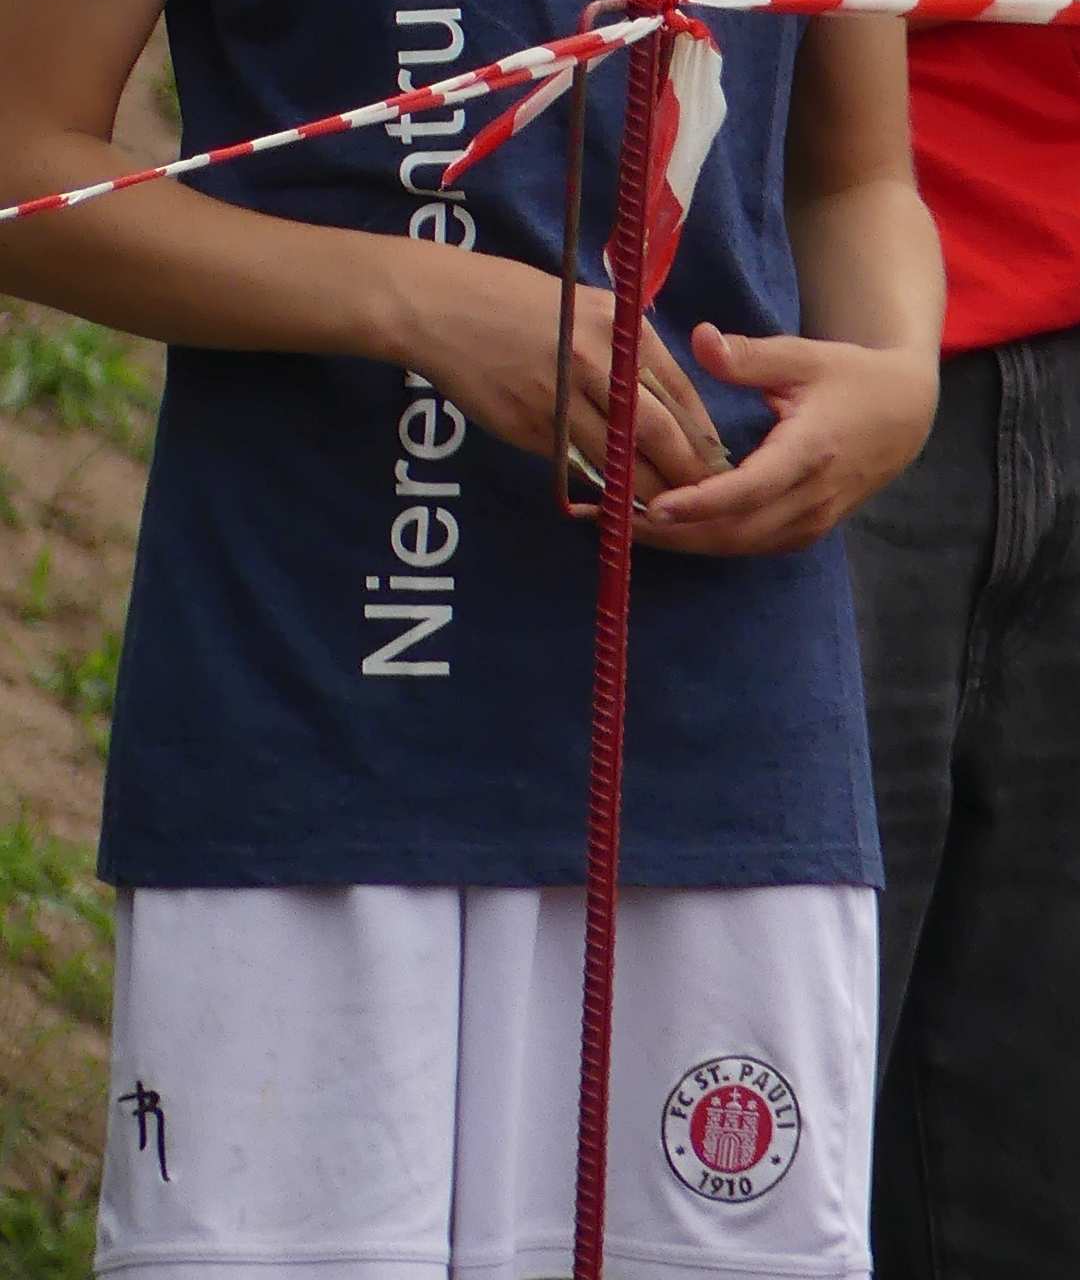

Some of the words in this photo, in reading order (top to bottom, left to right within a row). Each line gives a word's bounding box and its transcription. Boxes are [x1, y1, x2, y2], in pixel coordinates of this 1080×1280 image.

[670, 1091, 694, 1121] FC
[694, 1064, 730, 1090] ST.
[738, 1063, 796, 1130] PAULI
[699, 1169, 753, 1197] 1910
